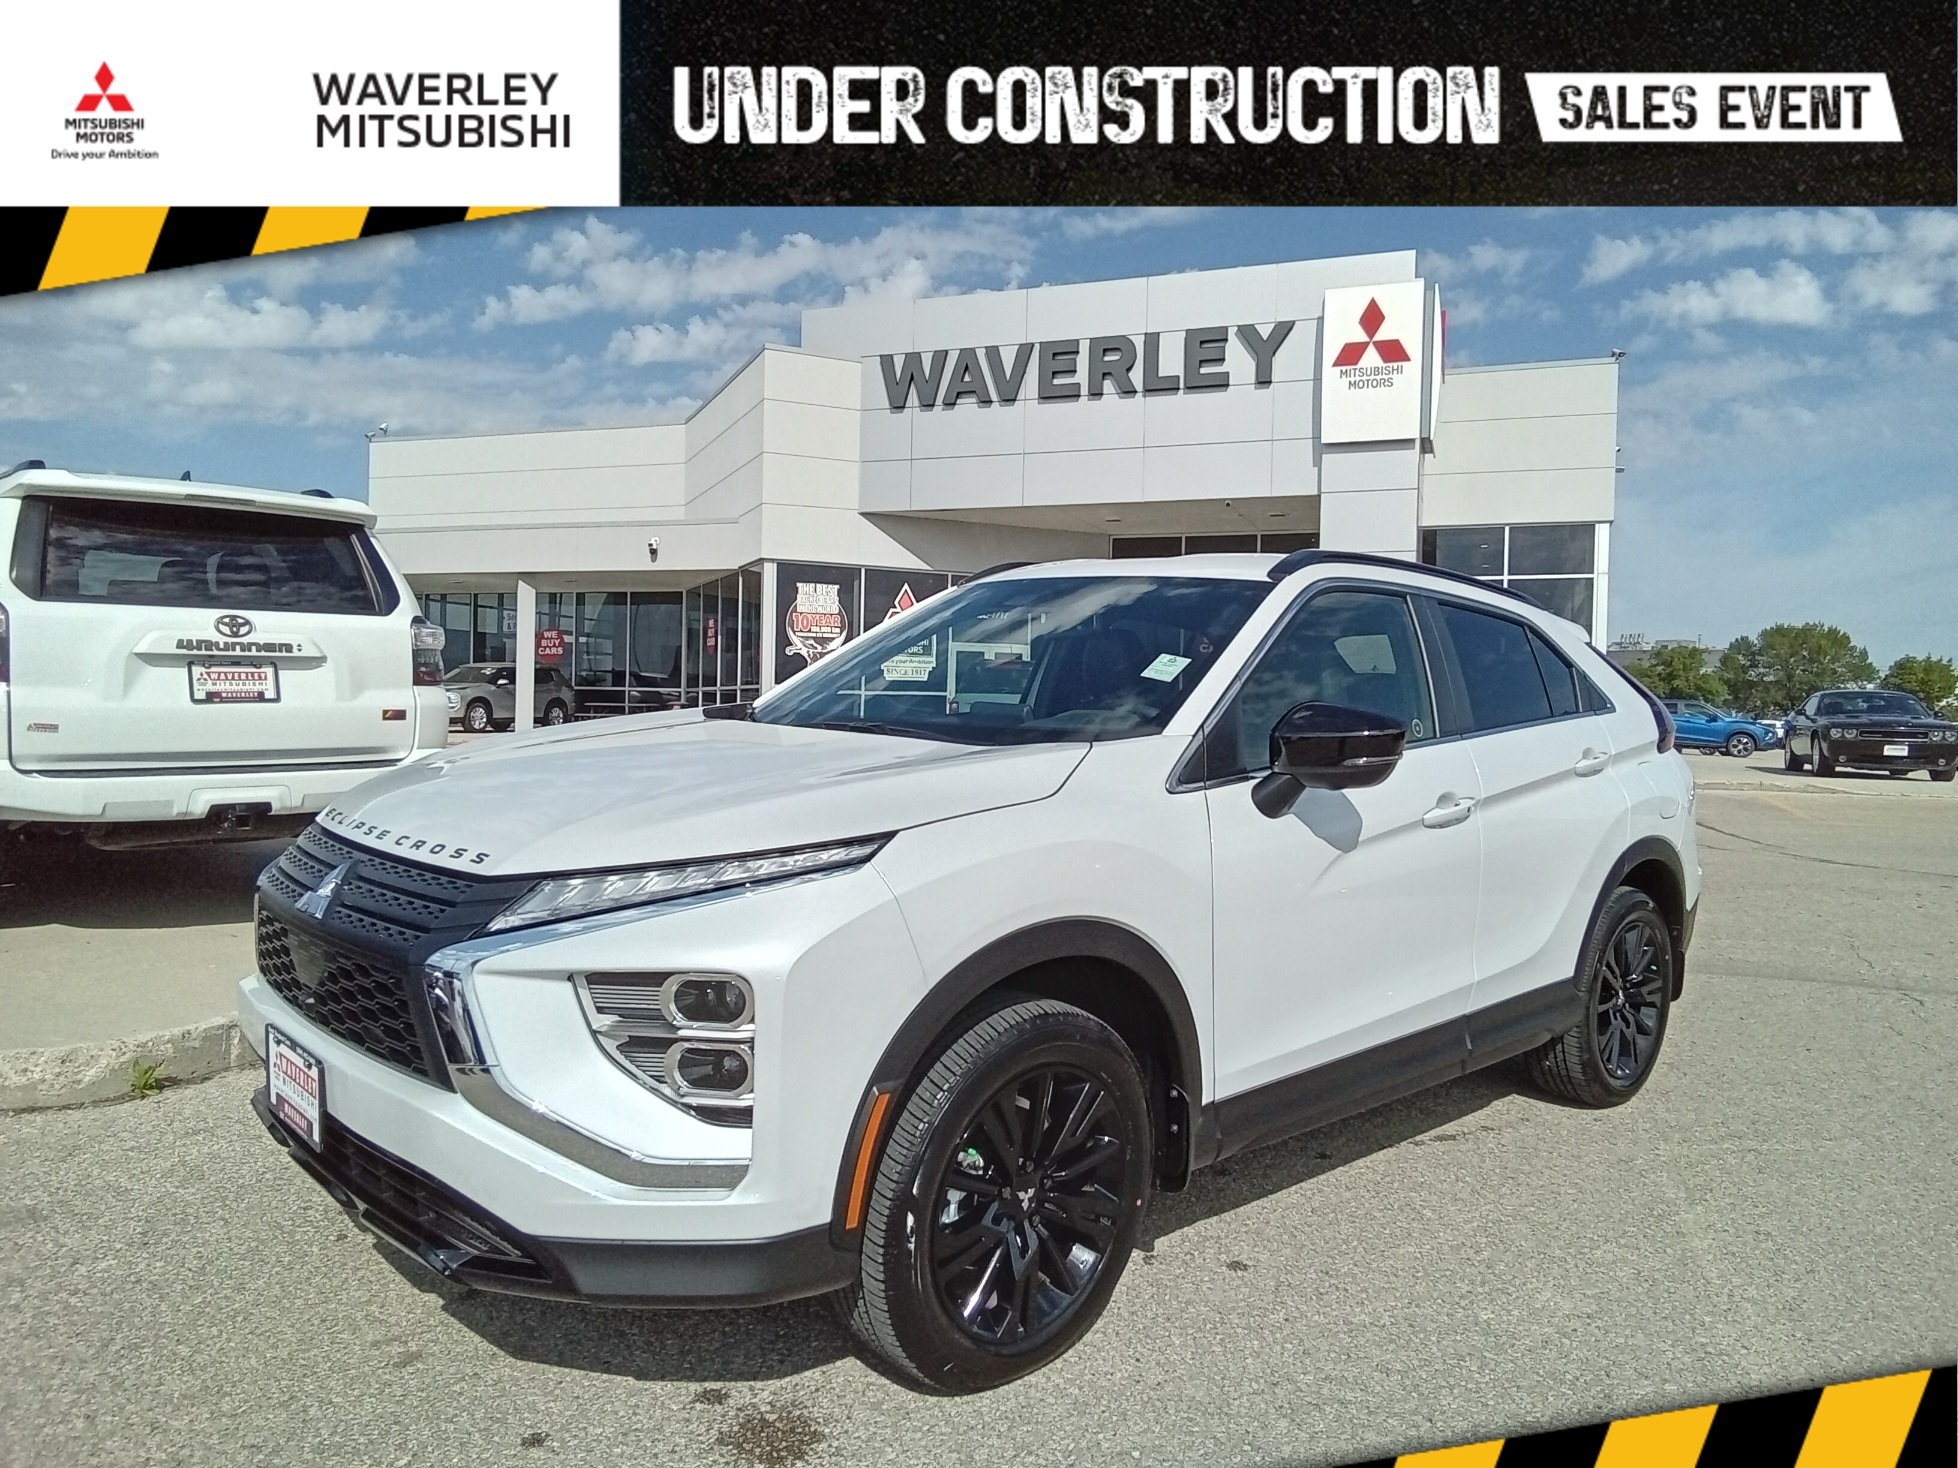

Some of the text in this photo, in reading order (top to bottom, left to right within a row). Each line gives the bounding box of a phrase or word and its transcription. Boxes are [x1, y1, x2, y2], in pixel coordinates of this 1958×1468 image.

[879, 320, 1295, 411] WAVERLEY
[1339, 364, 1404, 379] MITSUBISHI
[1347, 377, 1394, 391] MOTORS
[796, 582, 840, 597] THE BEST
[793, 612, 841, 631] 10 YEAR
[543, 630, 558, 638] WE
[541, 638, 560, 647] BUY
[538, 646, 563, 655] CARS
[209, 672, 267, 680] WAVERLEY
[886, 668, 927, 676] SINCE 1917
[325, 808, 491, 865] ECLIPSE CROSS
[280, 1055, 317, 1098] WAVERLEY
